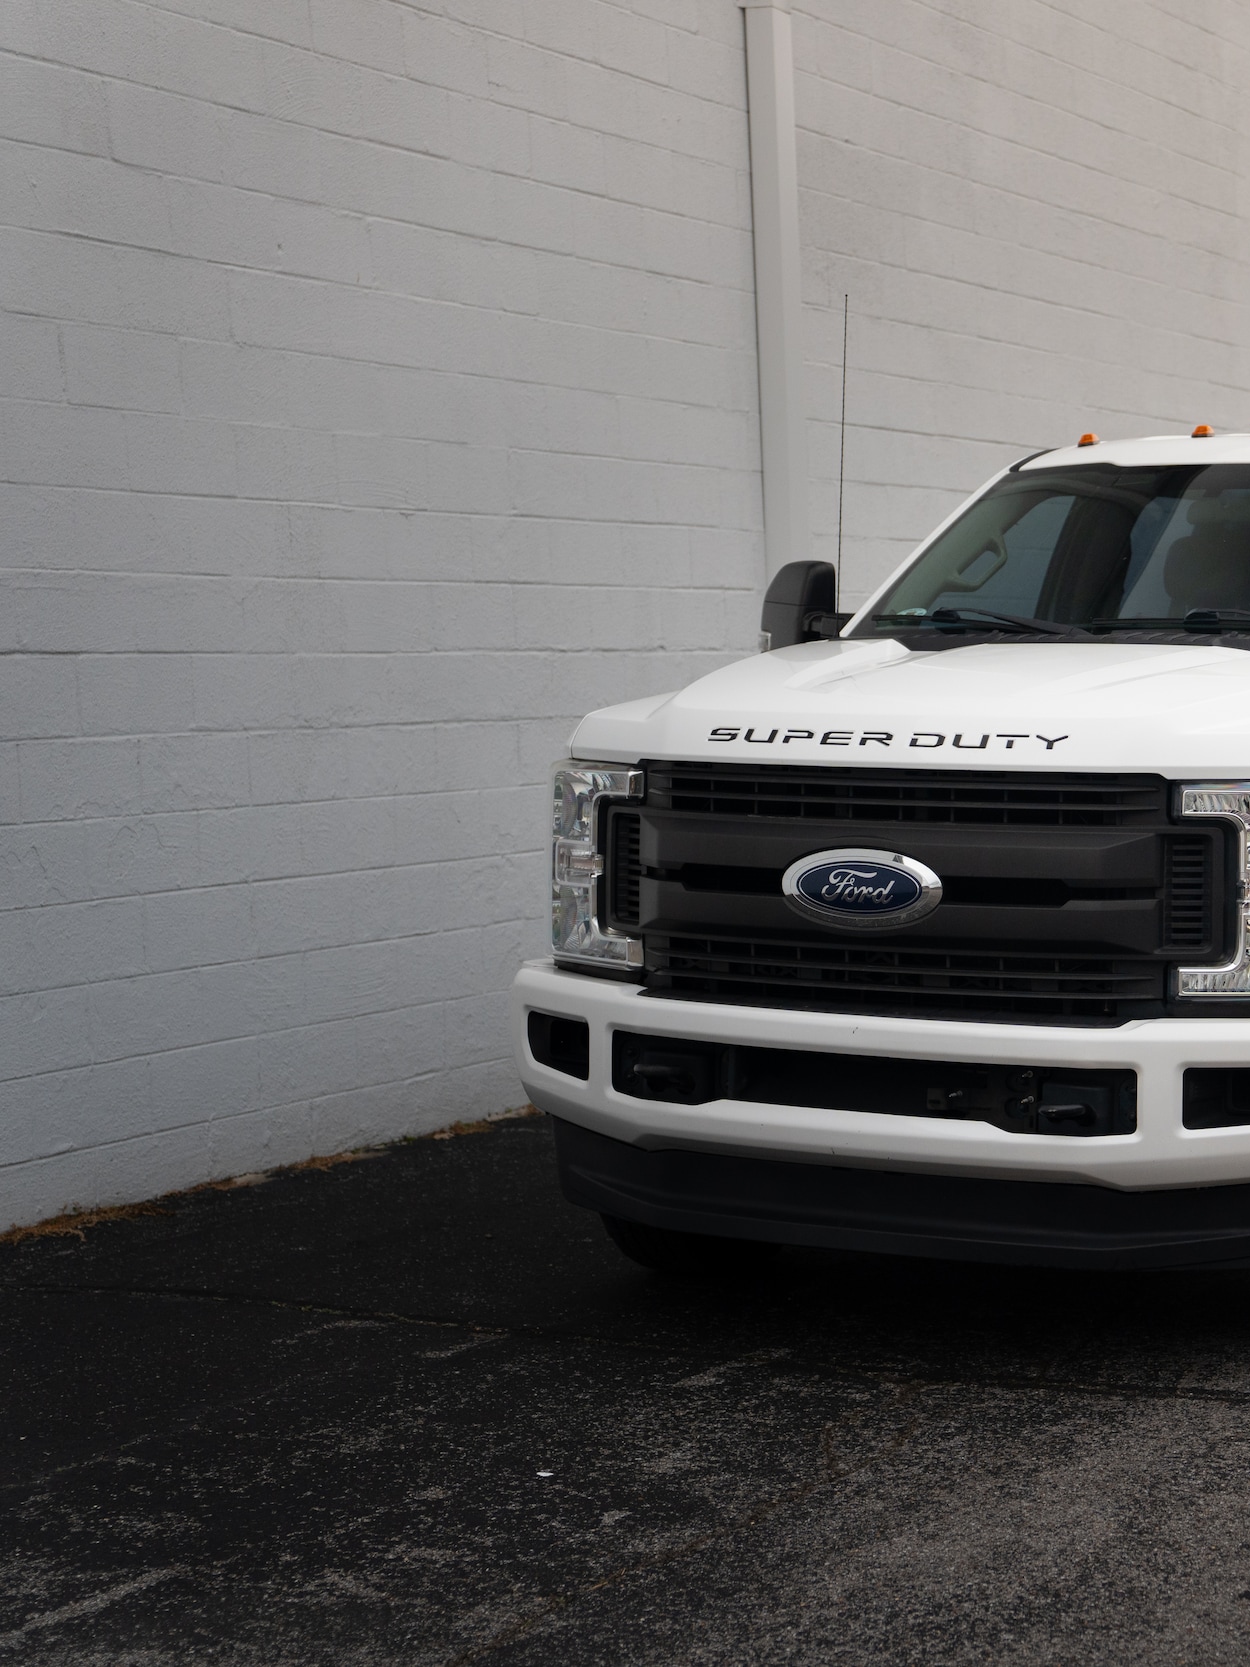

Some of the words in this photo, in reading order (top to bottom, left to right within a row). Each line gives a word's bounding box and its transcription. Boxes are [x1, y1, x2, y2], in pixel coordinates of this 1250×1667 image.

[707, 727, 894, 747] SUPER
[908, 732, 1070, 750] DUTY
[821, 868, 896, 904] Ford
